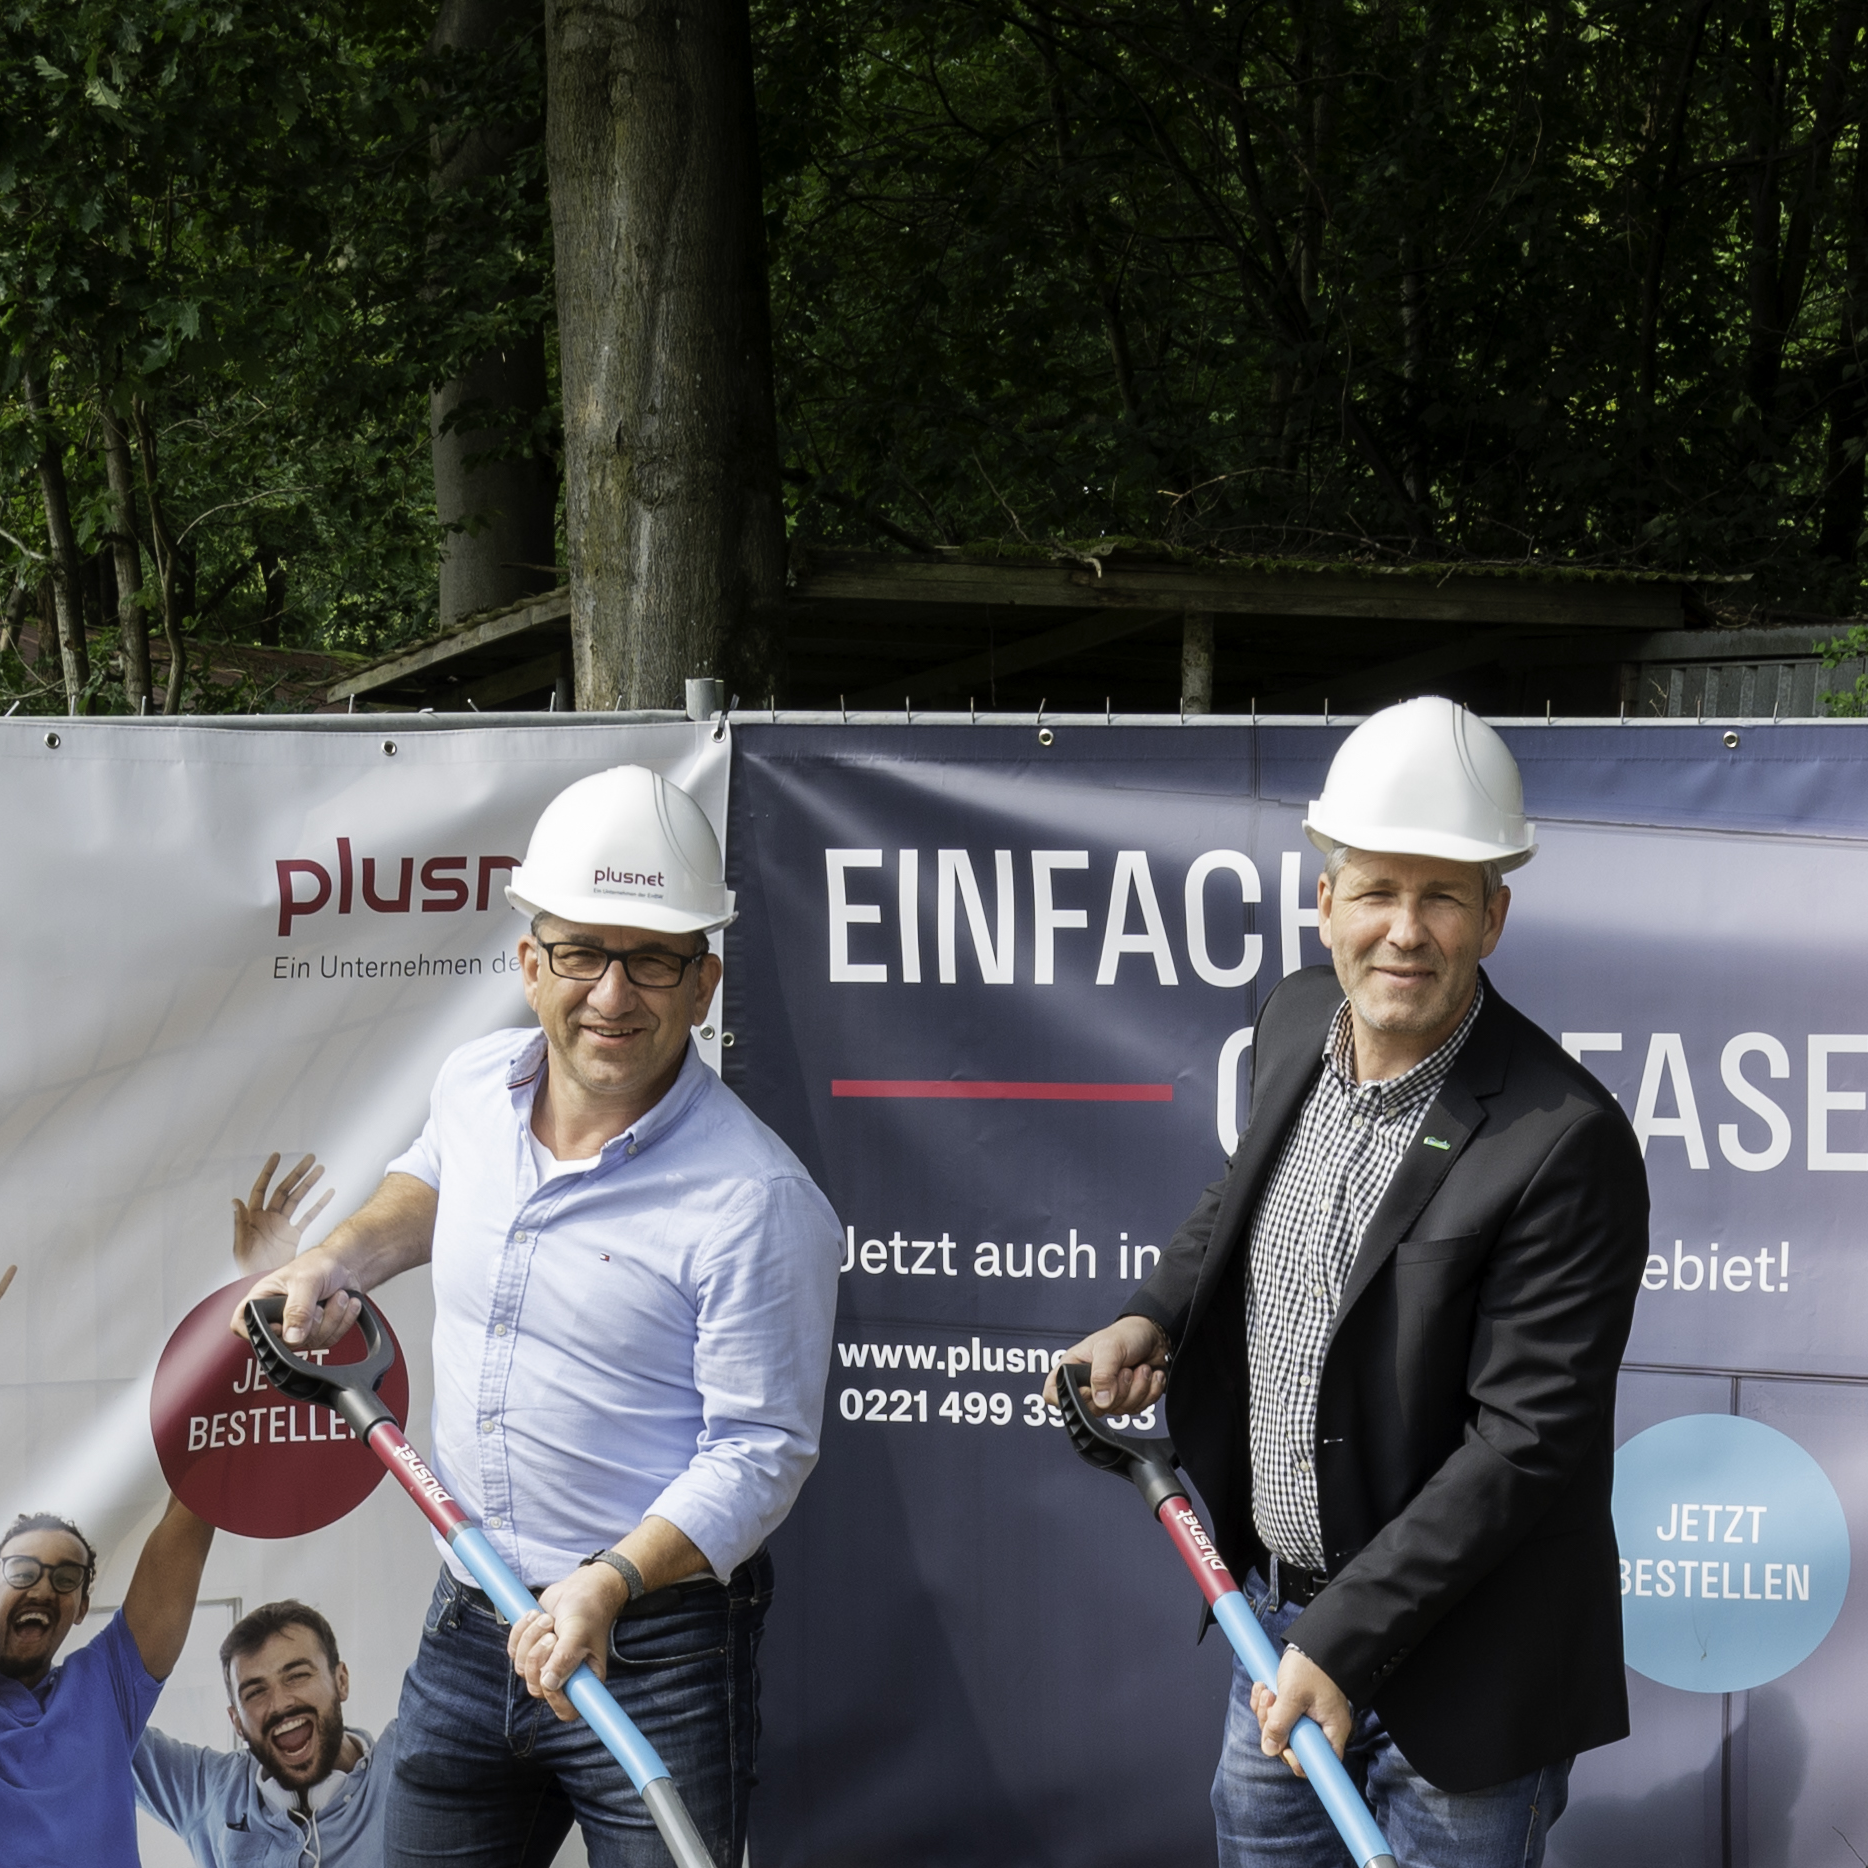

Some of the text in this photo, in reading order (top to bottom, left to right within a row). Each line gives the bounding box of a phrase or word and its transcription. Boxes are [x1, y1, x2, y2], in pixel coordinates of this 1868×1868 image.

[594, 866, 665, 887] plusnet
[273, 956, 310, 979] Ein
[321, 953, 482, 979] Unternehmen
[840, 1225, 958, 1276] Jetzt
[973, 1228, 1097, 1280] auch
[188, 1404, 357, 1451] BESTELLE
[839, 1388, 928, 1423] 0221
[938, 1391, 1013, 1426] 499
[393, 1443, 454, 1504] plusnet
[1176, 1509, 1228, 1571] plusnet
[1656, 1503, 1768, 1544] JETZT
[1619, 1558, 1810, 1601] BESTELLEN
